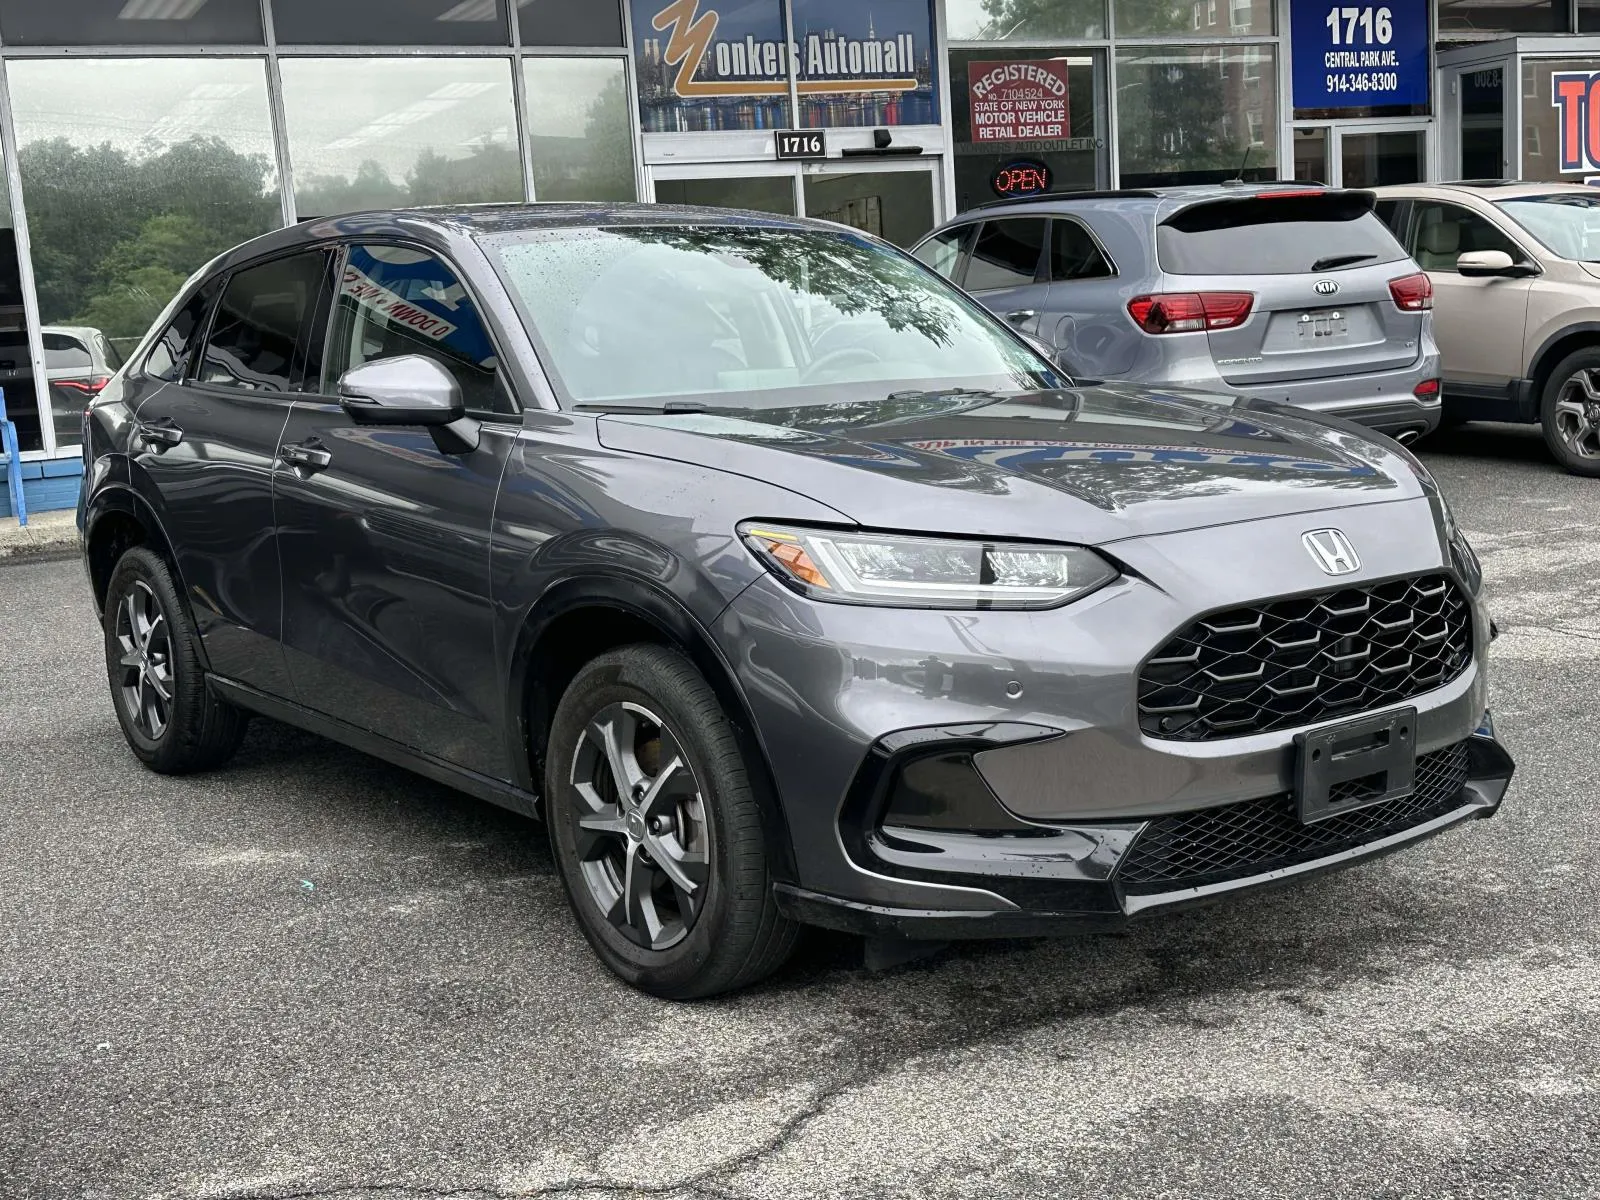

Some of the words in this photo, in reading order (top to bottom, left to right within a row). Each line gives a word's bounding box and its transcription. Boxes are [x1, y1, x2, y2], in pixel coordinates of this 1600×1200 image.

[1326, 7, 1393, 45] 1716
[808, 34, 914, 75] Automall
[1325, 51, 1360, 68] CENTRAL
[1360, 51, 1381, 67] PARK
[1381, 50, 1400, 66] AVE.
[972, 64, 1066, 98] REGISTERED
[1326, 72, 1397, 93] 914-346-8300
[1001, 88, 1043, 100] 7104524
[974, 102, 998, 112] STATE
[1000, 101, 1013, 111] OF
[1015, 101, 1037, 110] NEW
[1039, 100, 1065, 109] YORK
[975, 112, 1016, 125] MOTOR
[1018, 110, 1065, 123] VEHICLE
[979, 126, 1016, 139] RETAIL
[1018, 124, 1062, 137] DEALER
[782, 136, 821, 153] 1716
[1015, 140, 1042, 151] AUTO
[1043, 139, 1084, 150] OUTLET
[1086, 138, 1103, 149] INC
[996, 168, 1047, 191] OPEN
[1318, 282, 1339, 293] KIA
